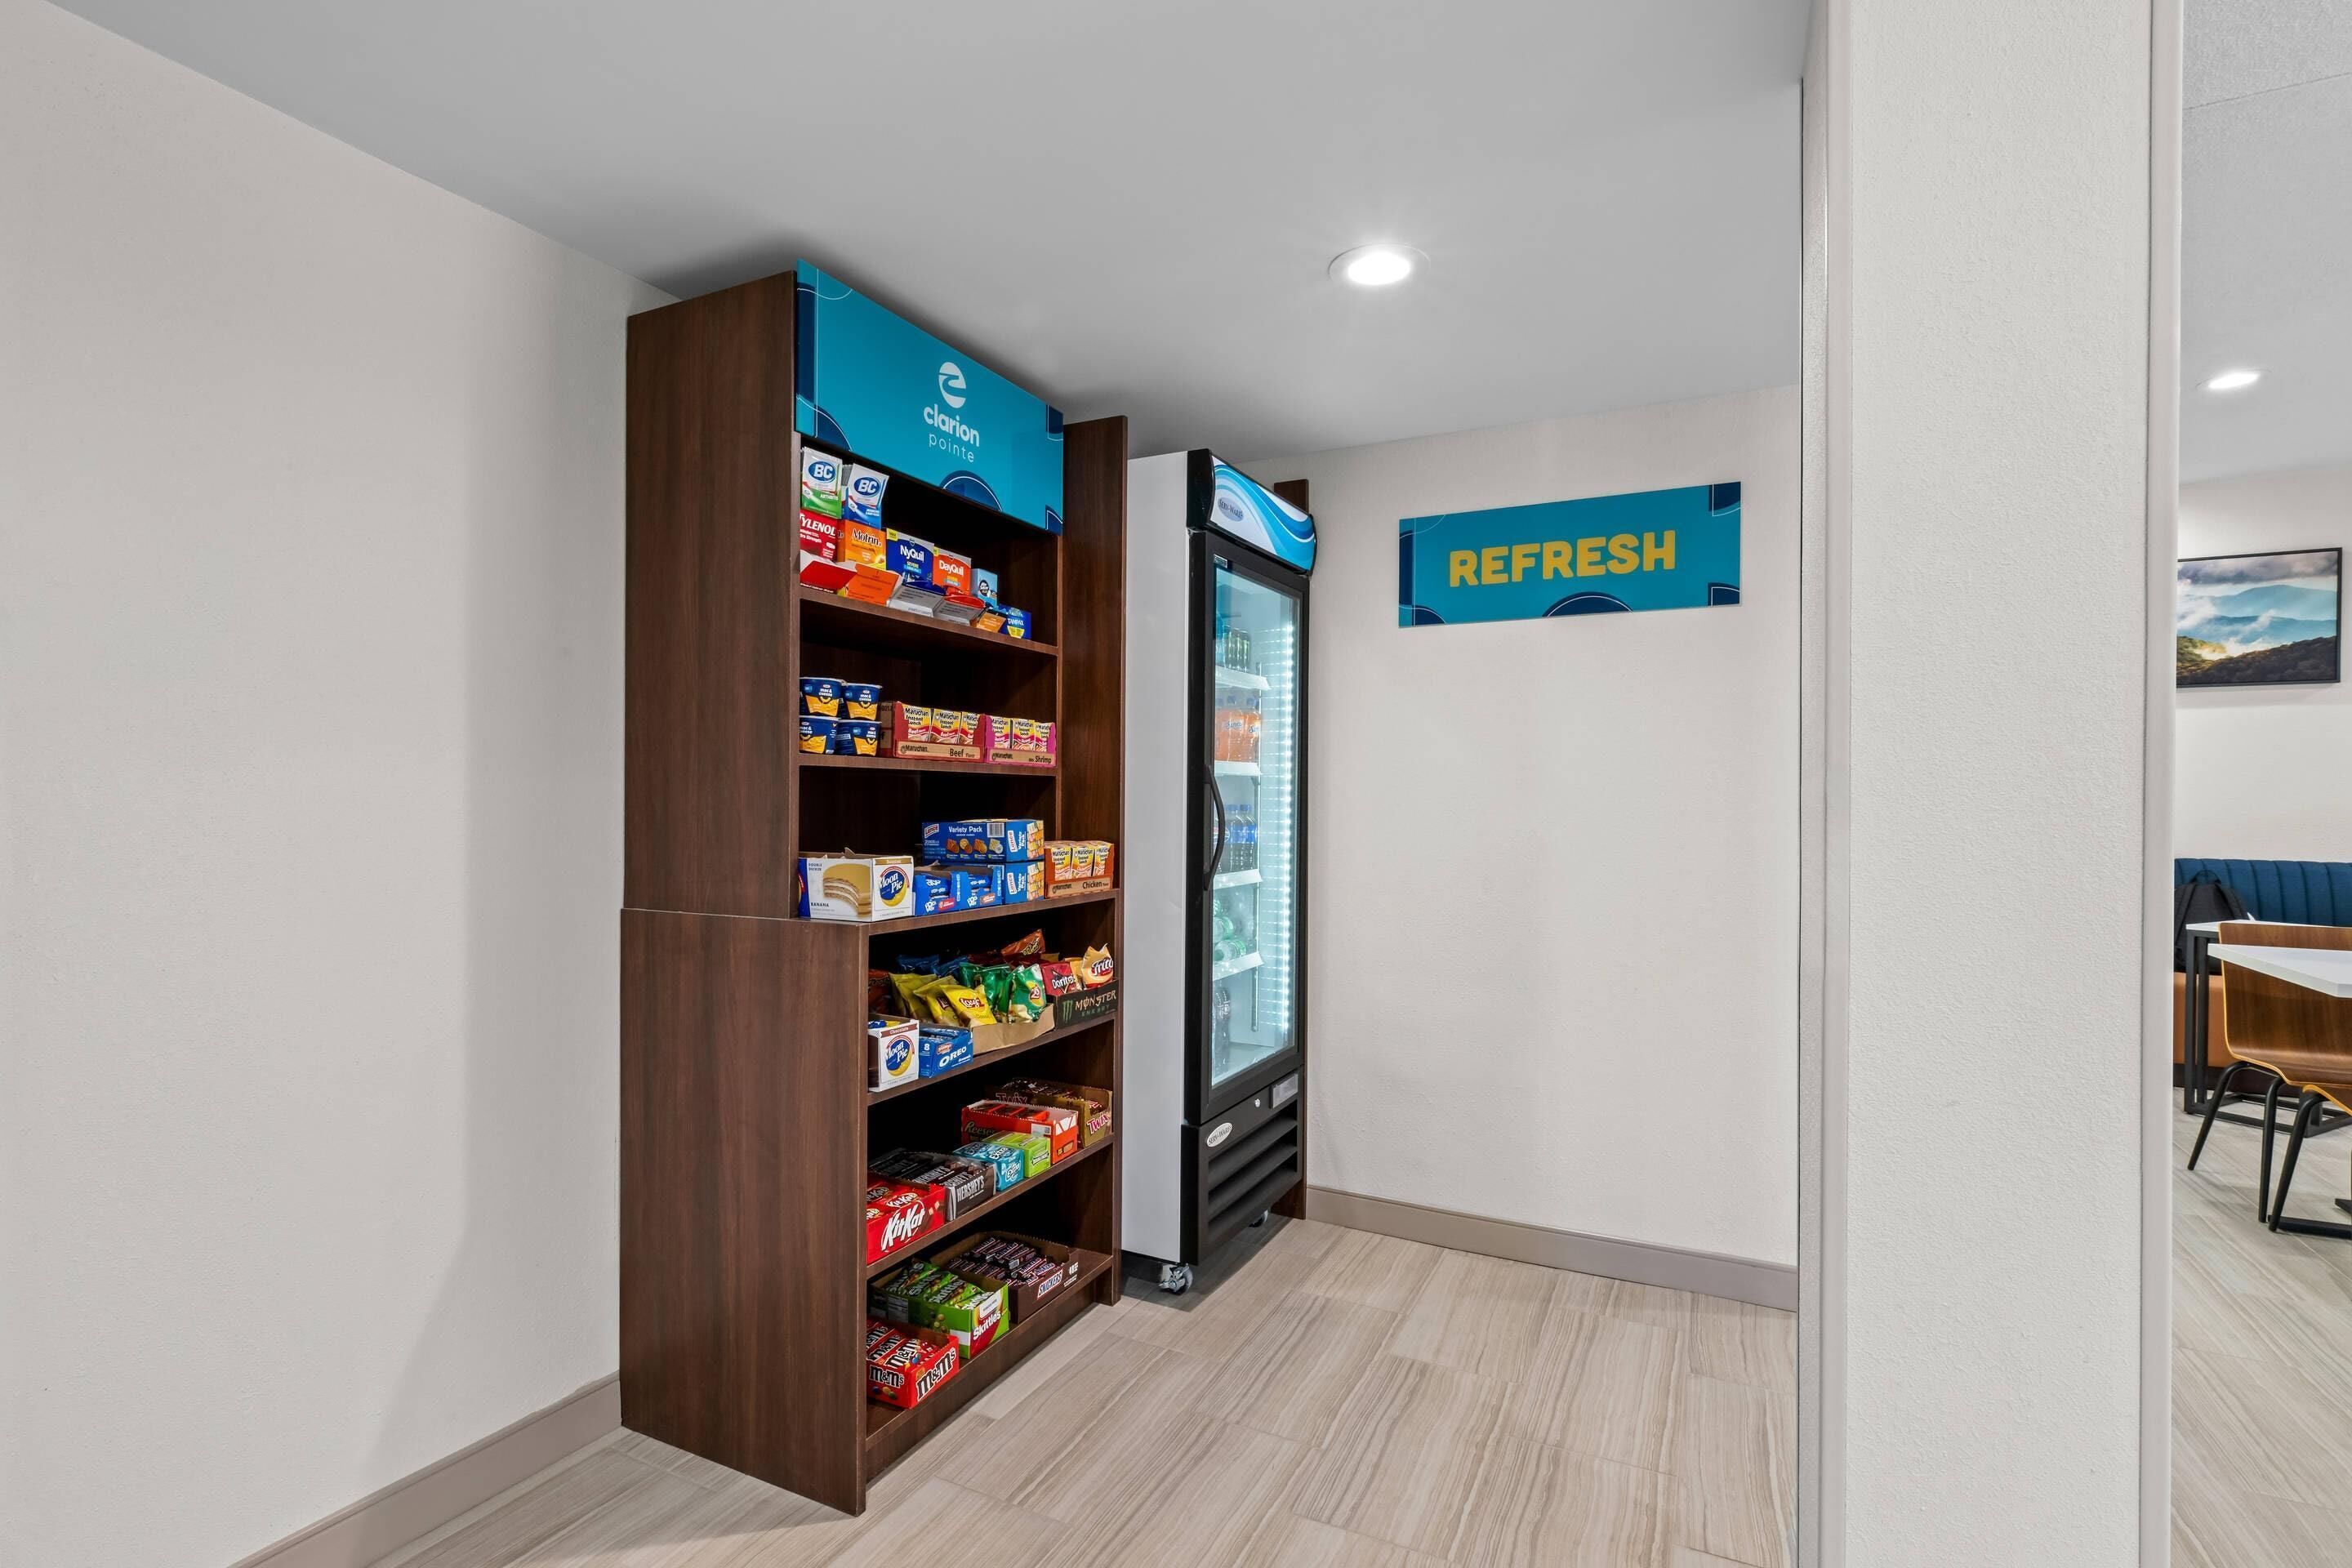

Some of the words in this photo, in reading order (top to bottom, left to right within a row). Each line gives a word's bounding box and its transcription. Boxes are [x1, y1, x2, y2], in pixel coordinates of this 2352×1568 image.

[924, 403, 980, 448] clarion
[929, 433, 975, 463] pointe
[813, 464, 833, 479] BC
[858, 479, 877, 493] BC
[853, 528, 879, 546] Motrin
[900, 545, 924, 563] NyQuil
[1450, 530, 1676, 587] REFRESH
[938, 559, 964, 577] DayQuil
[905, 708, 929, 716] Maruchan
[950, 748, 964, 757] Beef
[1035, 756, 1051, 764] Shrimp
[890, 880, 902, 893] Pie
[1082, 881, 1102, 889] Chicken
[1076, 990, 1116, 1011] MONSTER
[897, 1048, 908, 1062] Pie
[939, 1046, 967, 1067] OREO
[1086, 1111, 1109, 1134] Twix
[956, 1175, 985, 1202] HERSHEY'S
[1038, 1272, 1062, 1296] SNICKERS
[973, 1310, 1001, 1340] Skittles
